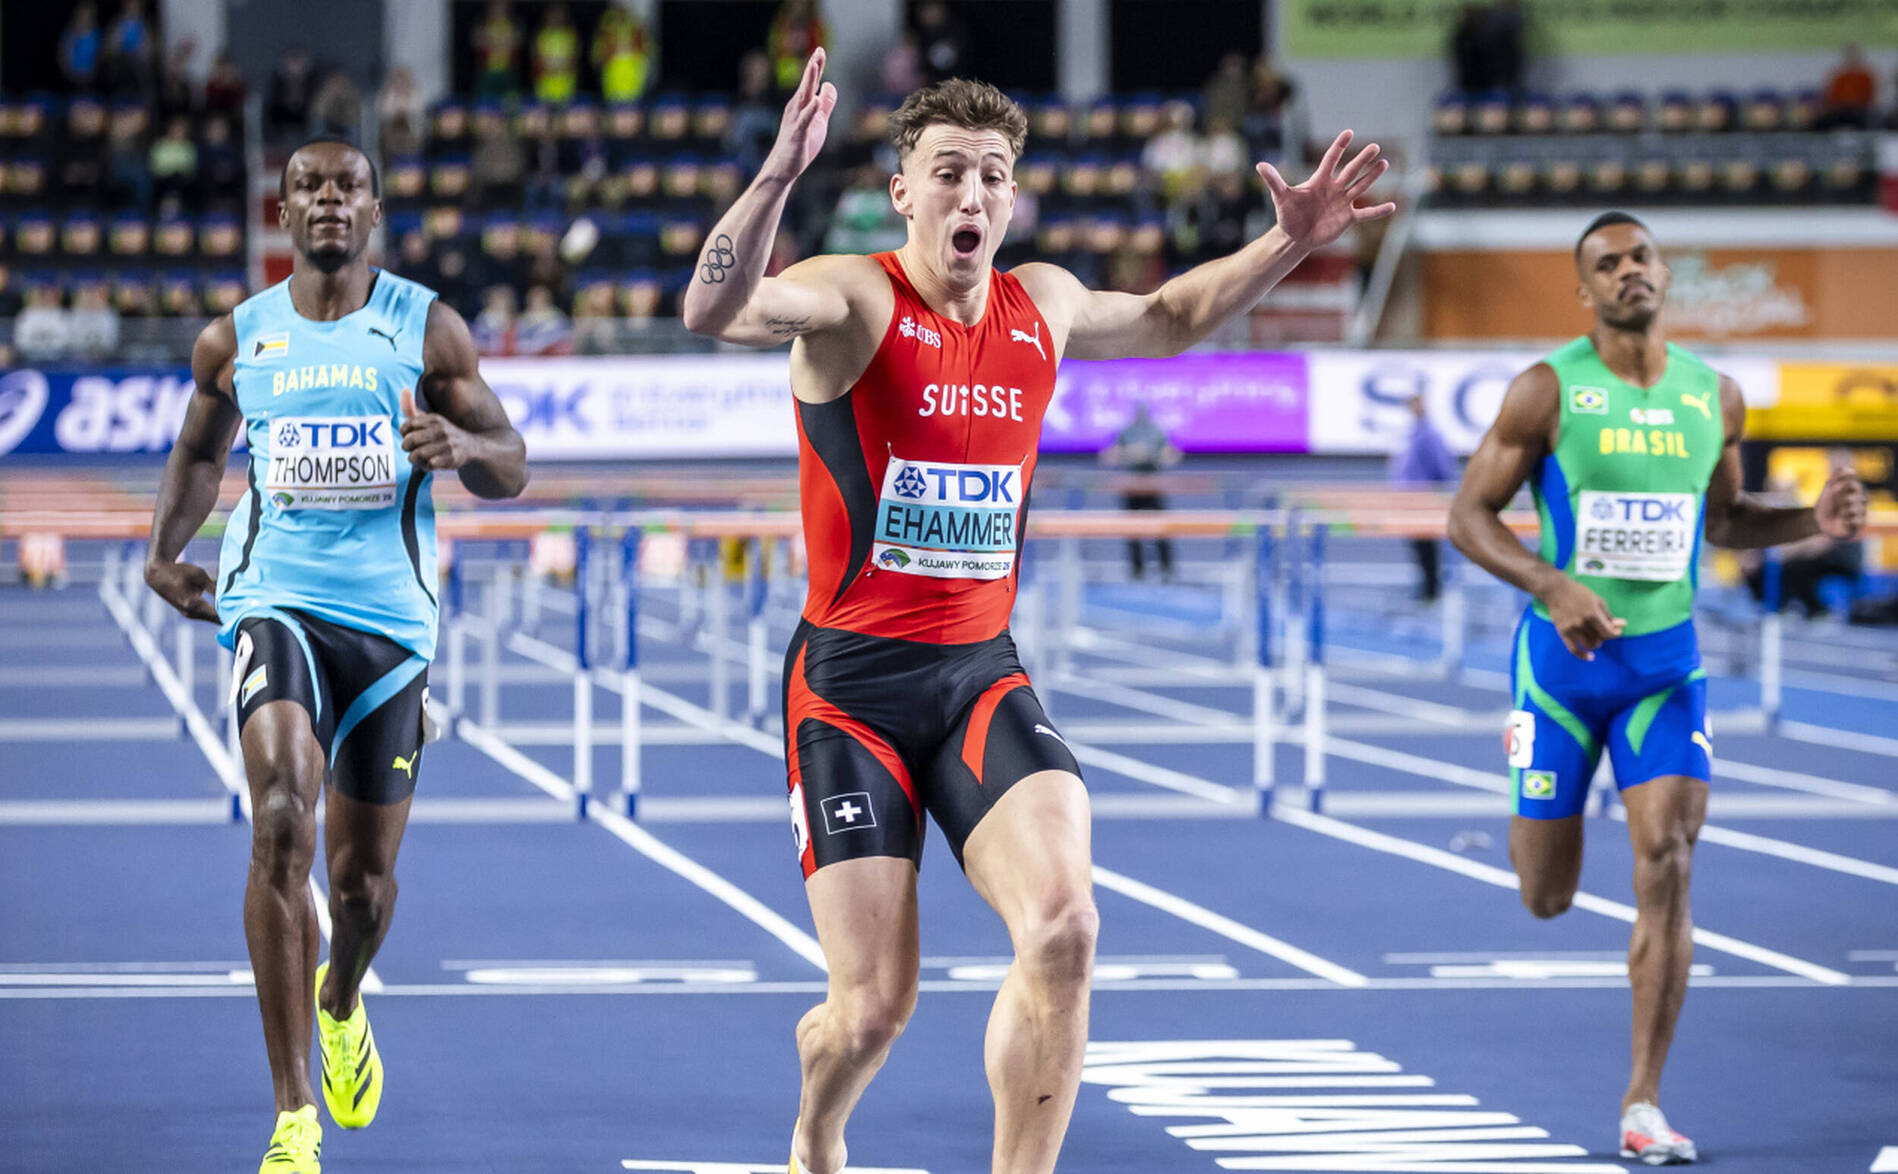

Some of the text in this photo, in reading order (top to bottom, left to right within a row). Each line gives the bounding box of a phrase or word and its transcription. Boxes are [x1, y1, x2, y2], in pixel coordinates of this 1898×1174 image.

[917, 324, 941, 348] UBS
[273, 364, 377, 397] BAHAMAS
[918, 384, 1023, 422] SUISSE
[301, 421, 383, 448] TDK
[1599, 427, 1690, 458] BRASIL
[275, 454, 391, 483] THOMPSON
[926, 468, 1014, 503] TDK
[1616, 498, 1685, 522] TDK
[885, 505, 1012, 546] EHAMMER
[918, 556, 960, 570] KUJAWY
[961, 559, 1002, 571] POMORZE
